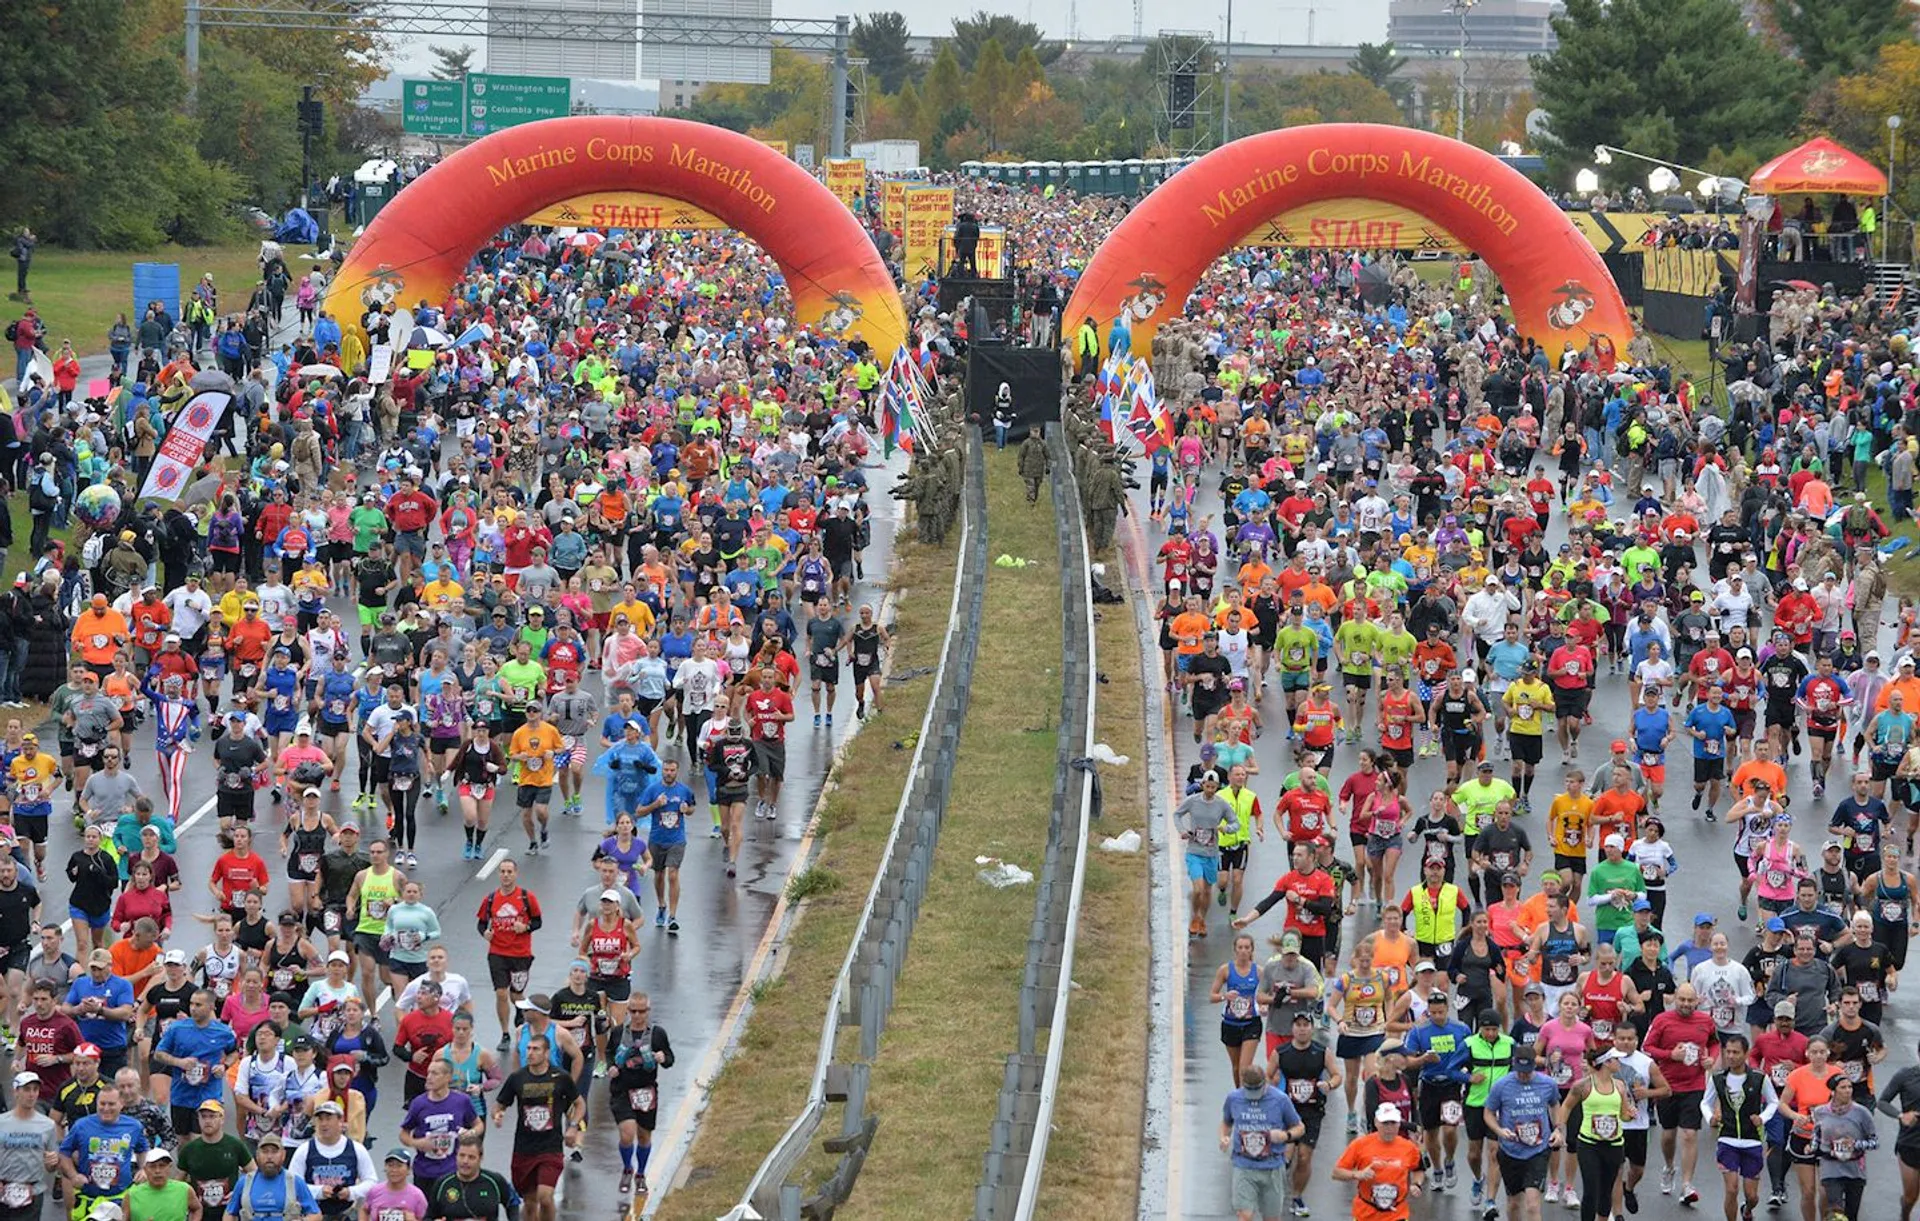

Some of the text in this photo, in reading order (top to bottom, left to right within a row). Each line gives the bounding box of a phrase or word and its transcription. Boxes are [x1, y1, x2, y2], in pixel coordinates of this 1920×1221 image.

[492, 84, 567, 94] Washington Blvd
[491, 106, 555, 115] Columbia Pike
[407, 114, 459, 124] Washington
[486, 138, 777, 214] Marine Corps Marathon
[1200, 149, 1519, 236] Marine Corps Marathon
[911, 194, 949, 202] EXPECTED
[934, 204, 951, 212] TIME
[591, 203, 663, 228] START
[1308, 218, 1404, 248] START
[26, 1027, 55, 1039] RACE
[26, 1043, 54, 1054] CURE
[1515, 1097, 1541, 1105] TRAVIS
[1241, 1112, 1267, 1120] TRAVIS
